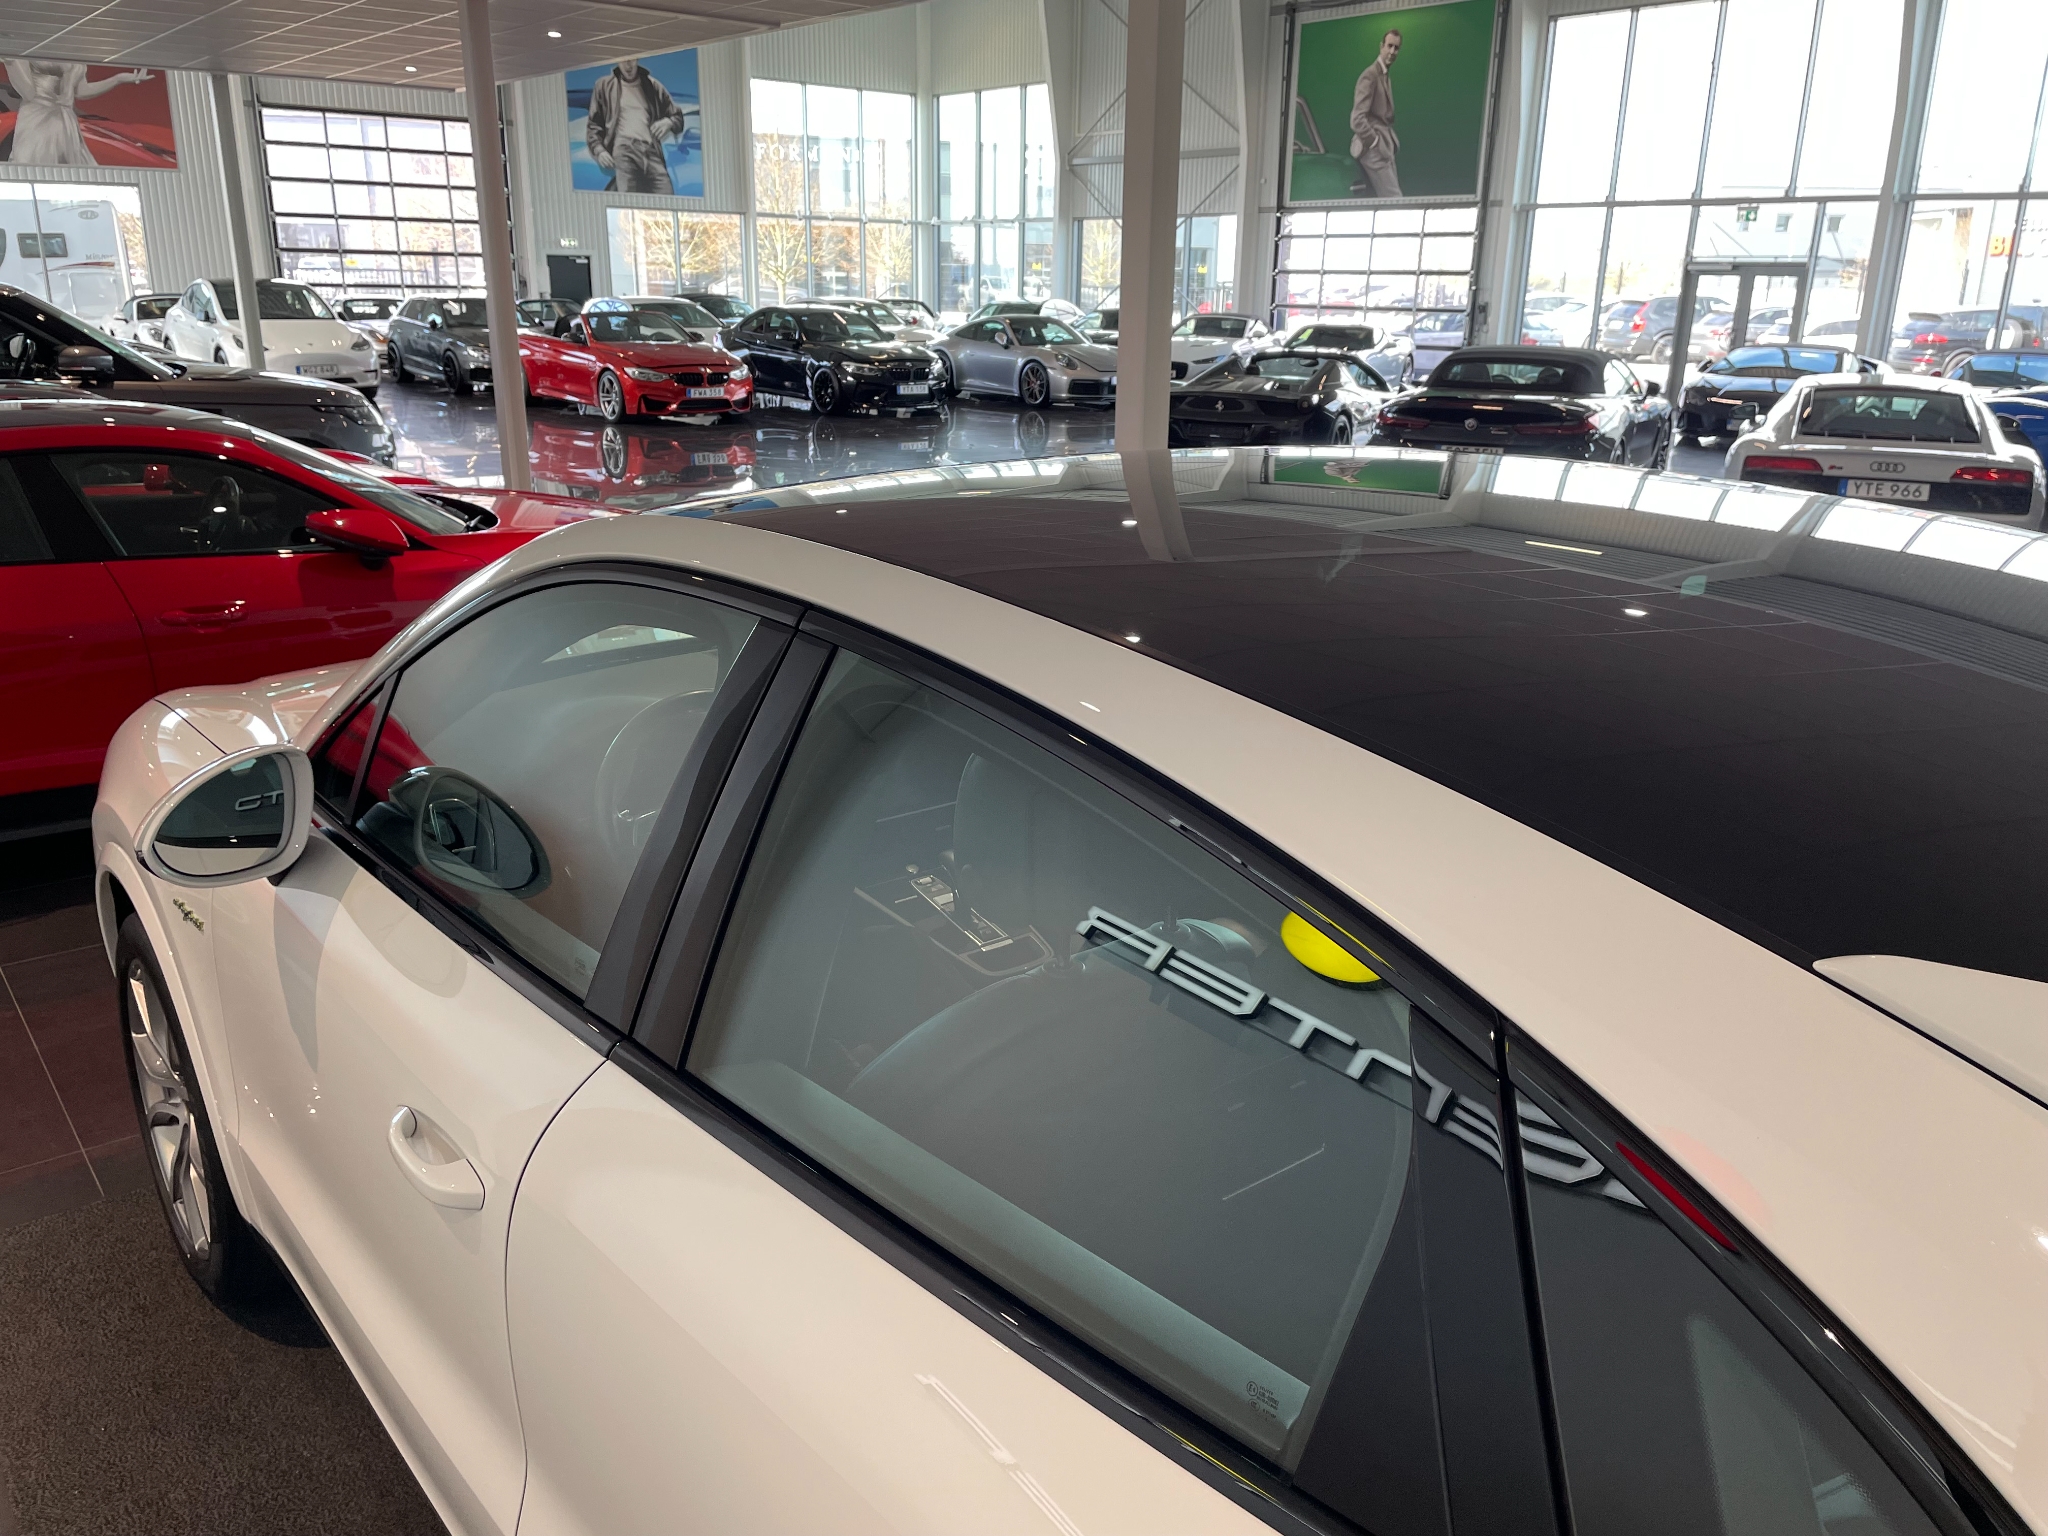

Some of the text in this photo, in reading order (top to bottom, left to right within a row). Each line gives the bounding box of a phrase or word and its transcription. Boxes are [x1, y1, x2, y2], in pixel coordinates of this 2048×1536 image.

[693, 389, 707, 397] FWA
[1853, 480, 1923, 499] YTE 966
